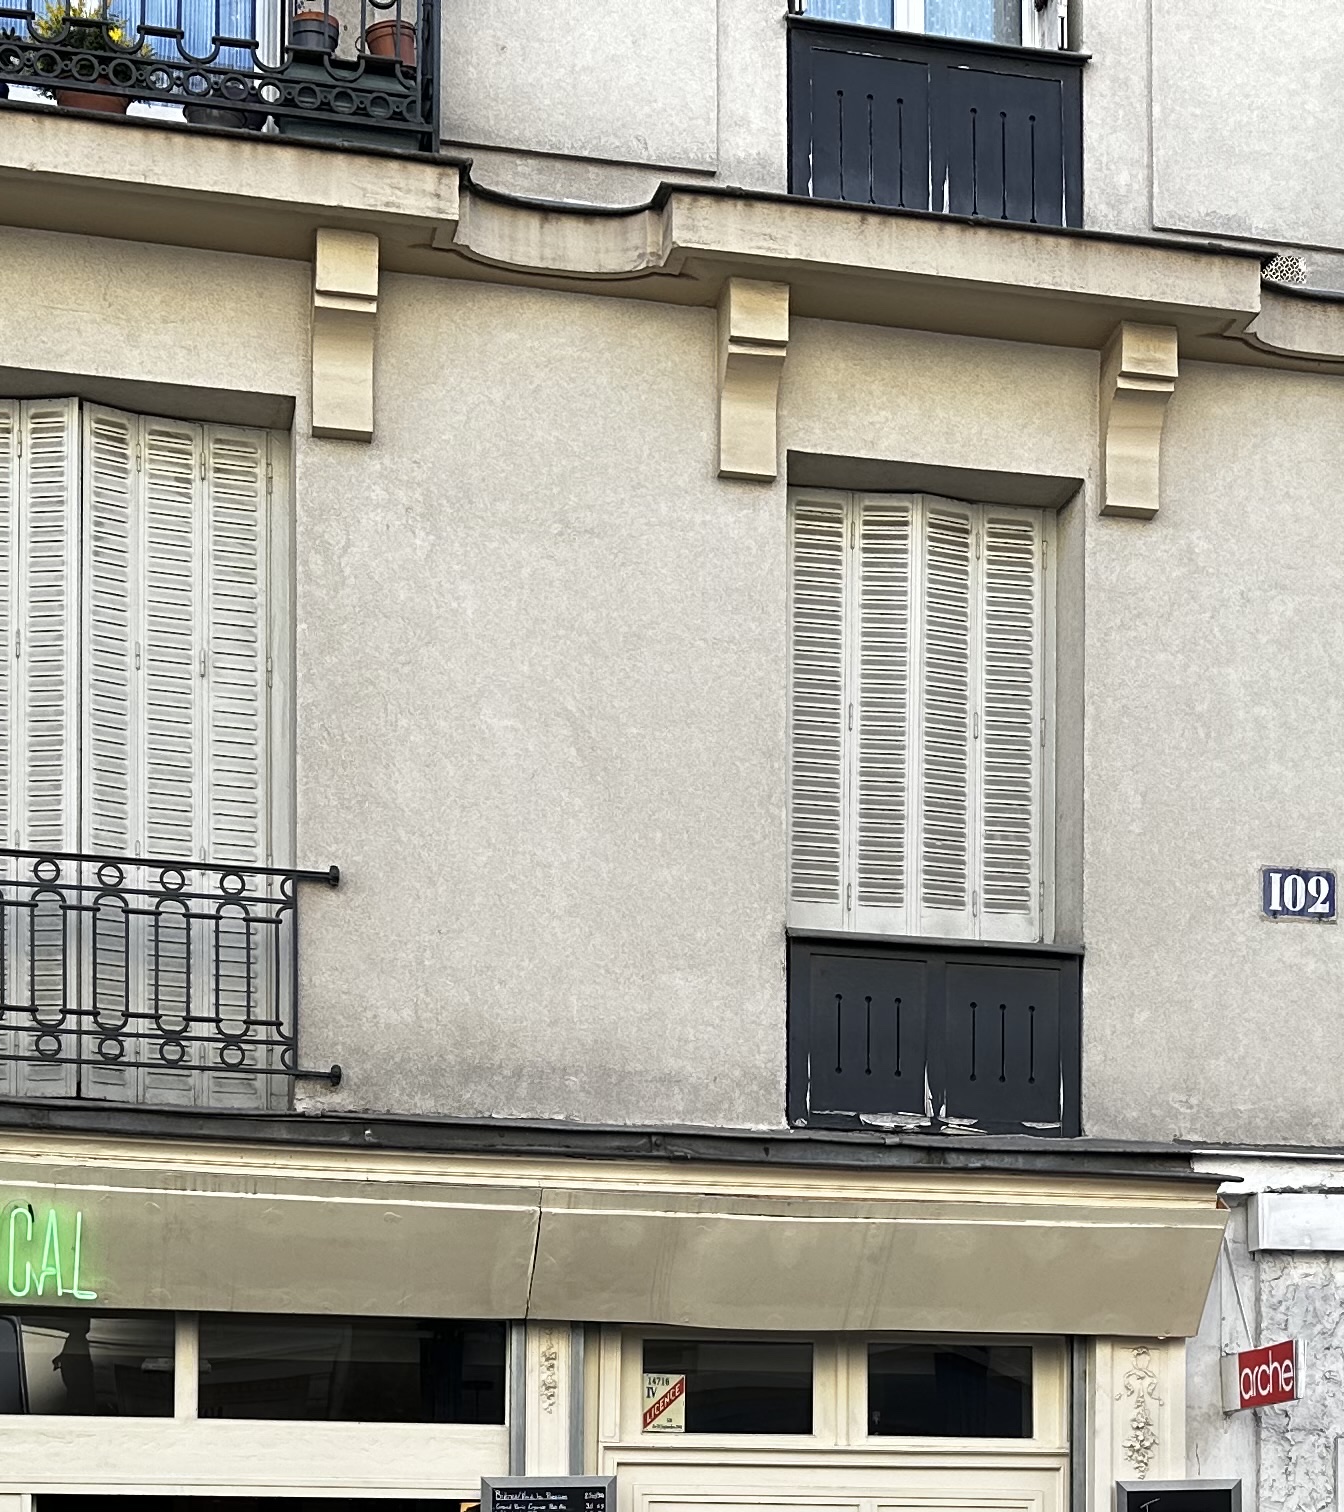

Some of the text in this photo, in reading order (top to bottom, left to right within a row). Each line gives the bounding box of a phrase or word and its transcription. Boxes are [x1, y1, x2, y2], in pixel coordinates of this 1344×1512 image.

[1269, 872, 1330, 913] 102
[1240, 1349, 1294, 1400] arche
[646, 1383, 681, 1424] LICENCE
